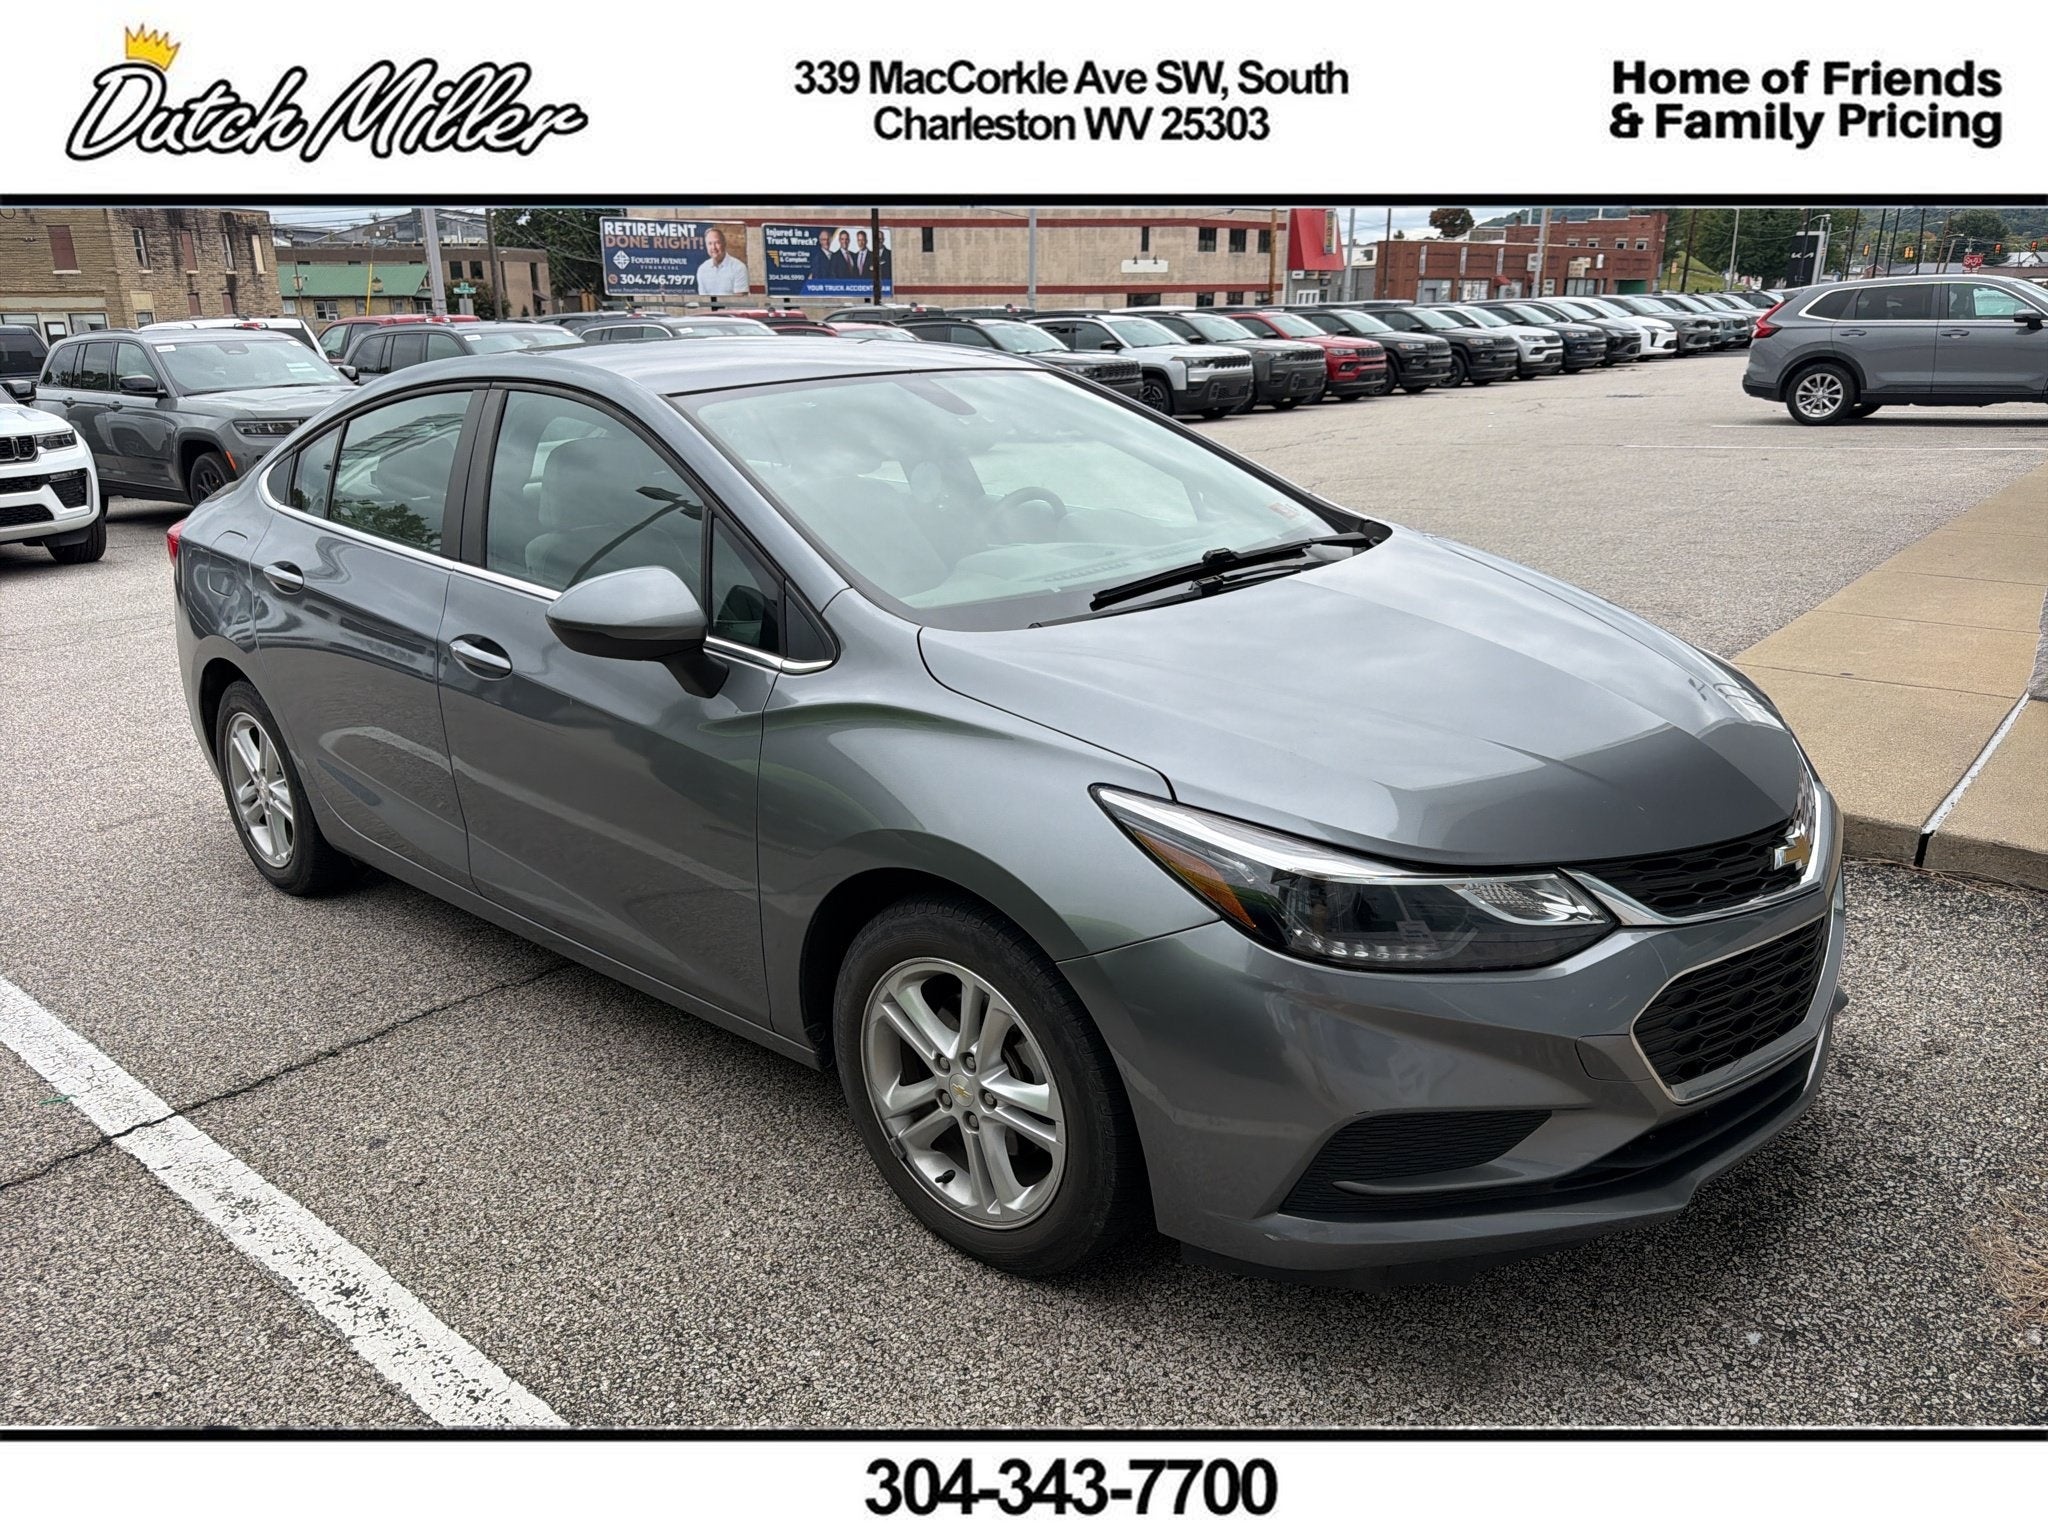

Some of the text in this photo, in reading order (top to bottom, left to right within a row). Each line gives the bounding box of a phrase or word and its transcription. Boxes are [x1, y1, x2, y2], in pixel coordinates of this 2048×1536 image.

[604, 221, 697, 237] RETIREMENT
[766, 228, 794, 238] Injured
[795, 229, 803, 237] in
[605, 235, 704, 250] DONE RIGHT!
[767, 237, 817, 246] Truck Wreck?
[631, 256, 688, 265] FOURTH AVENUE
[620, 273, 695, 286] 304.746.7977
[806, 284, 823, 292] YOUR
[825, 284, 844, 292] TRUCK
